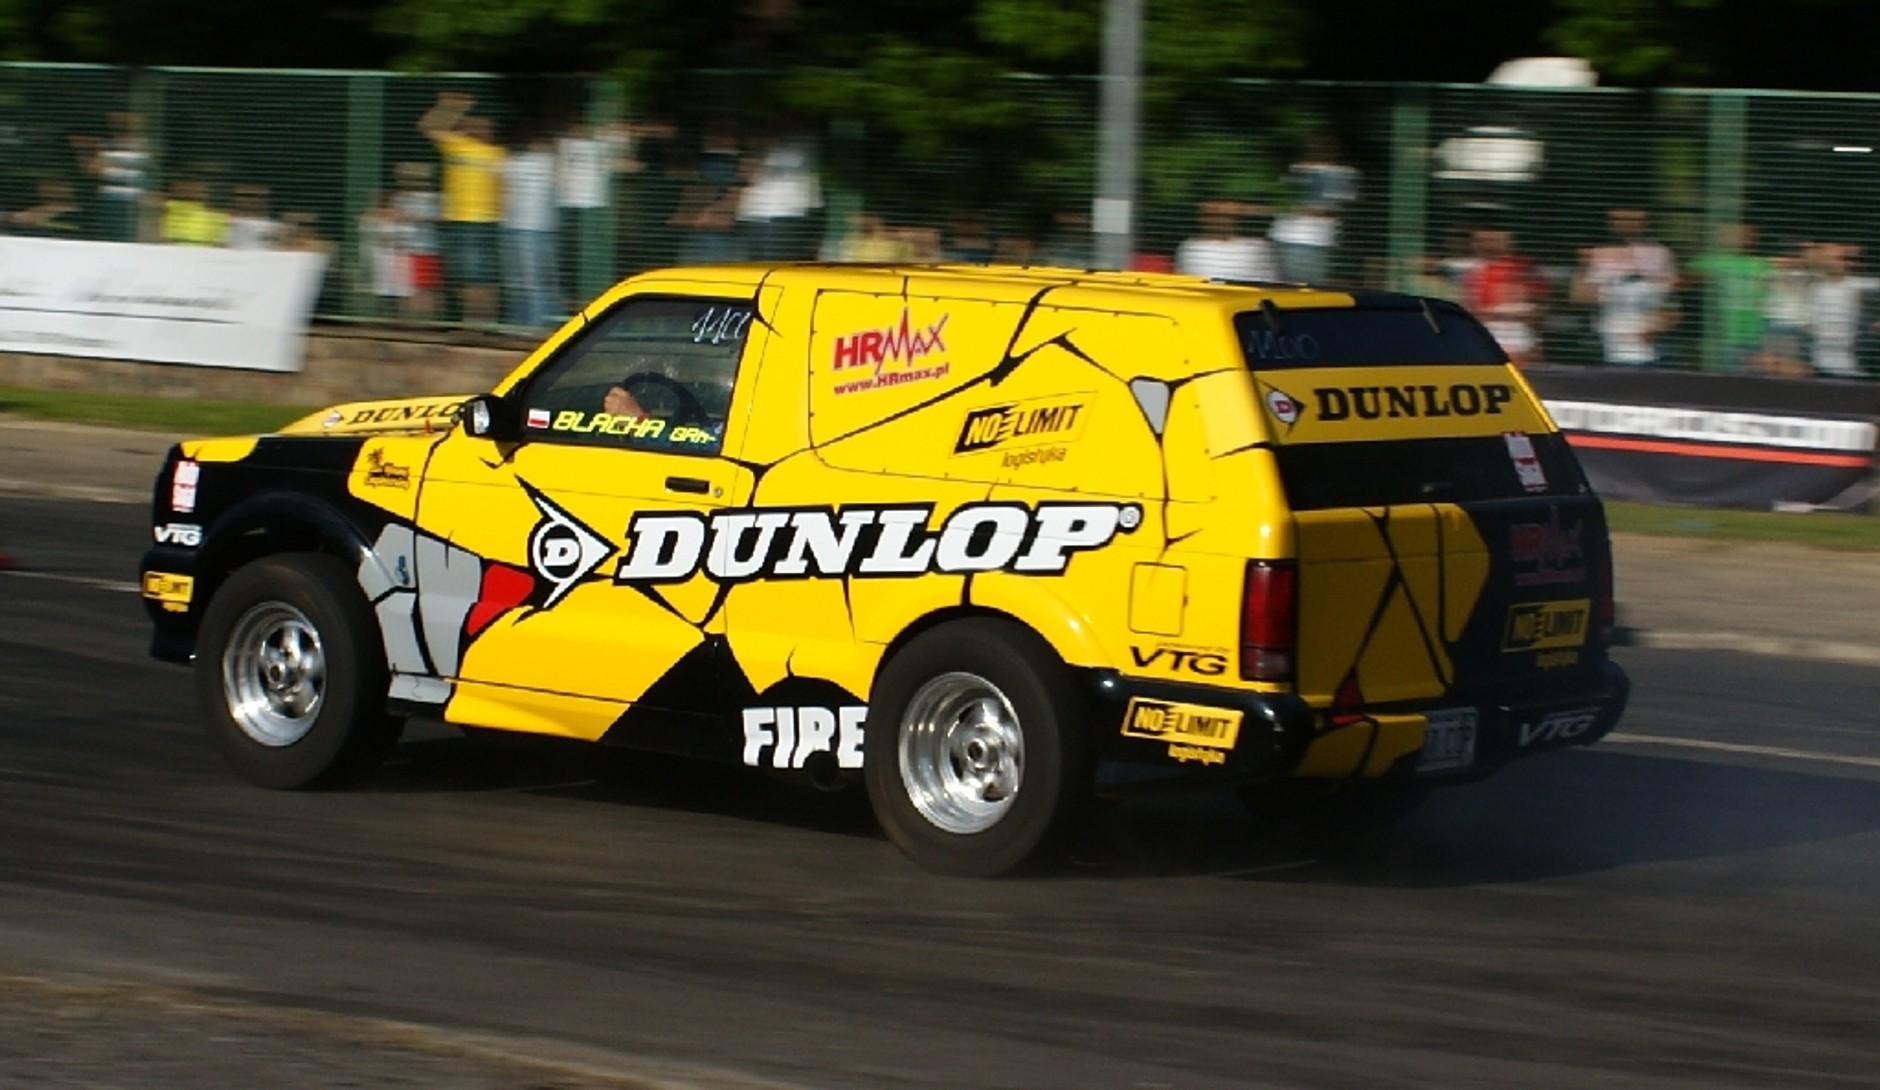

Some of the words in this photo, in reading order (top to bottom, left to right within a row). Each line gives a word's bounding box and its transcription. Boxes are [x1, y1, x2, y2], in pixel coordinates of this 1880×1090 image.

[833, 362, 950, 396] www.HRmax.pl
[1313, 384, 1512, 422] DUNLOP
[553, 411, 665, 438] BLACHA
[154, 526, 202, 547] VTG
[1129, 646, 1229, 676] VTG
[742, 706, 869, 768] FIRE
[1518, 714, 1596, 747] VTG
